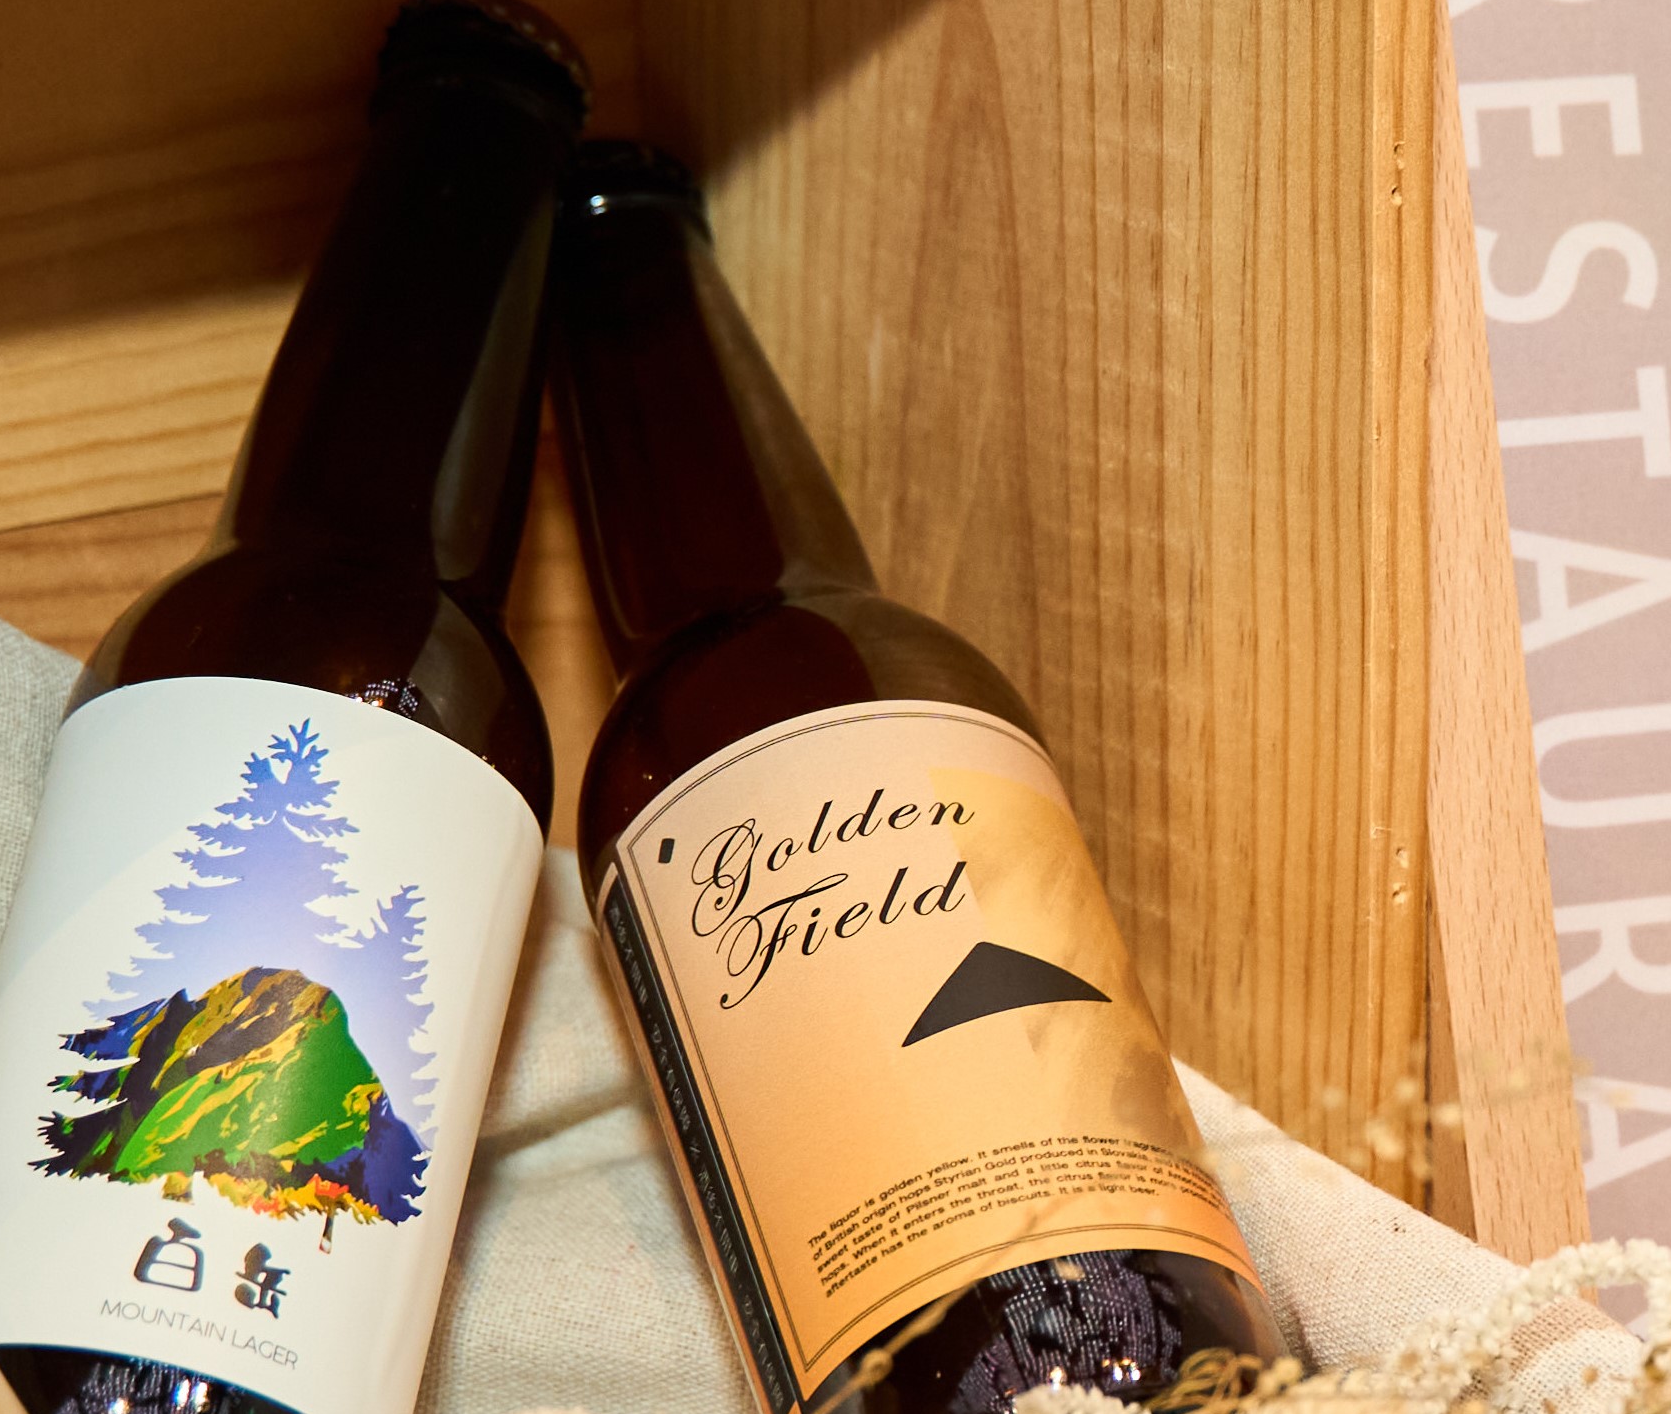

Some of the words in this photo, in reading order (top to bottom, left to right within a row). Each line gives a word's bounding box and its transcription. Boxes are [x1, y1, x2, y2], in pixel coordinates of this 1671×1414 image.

[690, 789, 974, 938] Golden
[717, 862, 969, 1010] Field
[808, 1230, 827, 1248] The
[830, 1206, 861, 1231] liquor
[864, 1197, 875, 1208] is
[879, 1173, 923, 1201] golden
[927, 1156, 973, 1178] yellow.
[977, 1151, 987, 1159] It
[992, 1140, 1035, 1155] smells
[1040, 1137, 1053, 1148] of
[1057, 1136, 1078, 1146] the
[1082, 1135, 1119, 1146] flower
[812, 1250, 823, 1261] of
[825, 1221, 860, 1251] British
[862, 1201, 896, 1225] origin
[898, 1185, 931, 1207] hops
[933, 1166, 981, 1188] Styrian
[984, 1157, 1017, 1171] Gold
[1020, 1147, 1084, 1163] produced
[1087, 1147, 1099, 1156] in
[817, 1244, 849, 1274] sweet
[853, 1222, 883, 1246] taste
[889, 1211, 902, 1224] of
[906, 1190, 951, 1214] Pilsner
[958, 1178, 987, 1193] malt
[994, 1169, 1019, 1182] and
[1026, 1166, 1034, 1175] a
[1040, 1161, 1069, 1172] little
[1075, 1159, 1111, 1169] citrus
[821, 1262, 850, 1287] hops.
[852, 1235, 886, 1261] When
[890, 1228, 899, 1238] it
[903, 1205, 945, 1230] enters
[950, 1195, 972, 1209] the
[977, 1182, 1024, 1200] throat,
[1028, 1176, 1050, 1186] the
[1056, 1172, 1094, 1182] citrus
[1136, 1174, 1146, 1183] is
[826, 1255, 878, 1298] aftertaste
[881, 1241, 905, 1257] has
[907, 1227, 928, 1242] the
[932, 1209, 975, 1230] aroma
[980, 1200, 993, 1212] of
[997, 1190, 1055, 1208] biscuits.
[1059, 1186, 1069, 1195] It
[1072, 1185, 1084, 1194] is
[1098, 1183, 1125, 1195] light
[1129, 1185, 1160, 1197] beer.
[100, 1299, 227, 1343] MOUNTAIN
[231, 1329, 299, 1370] LAGER
